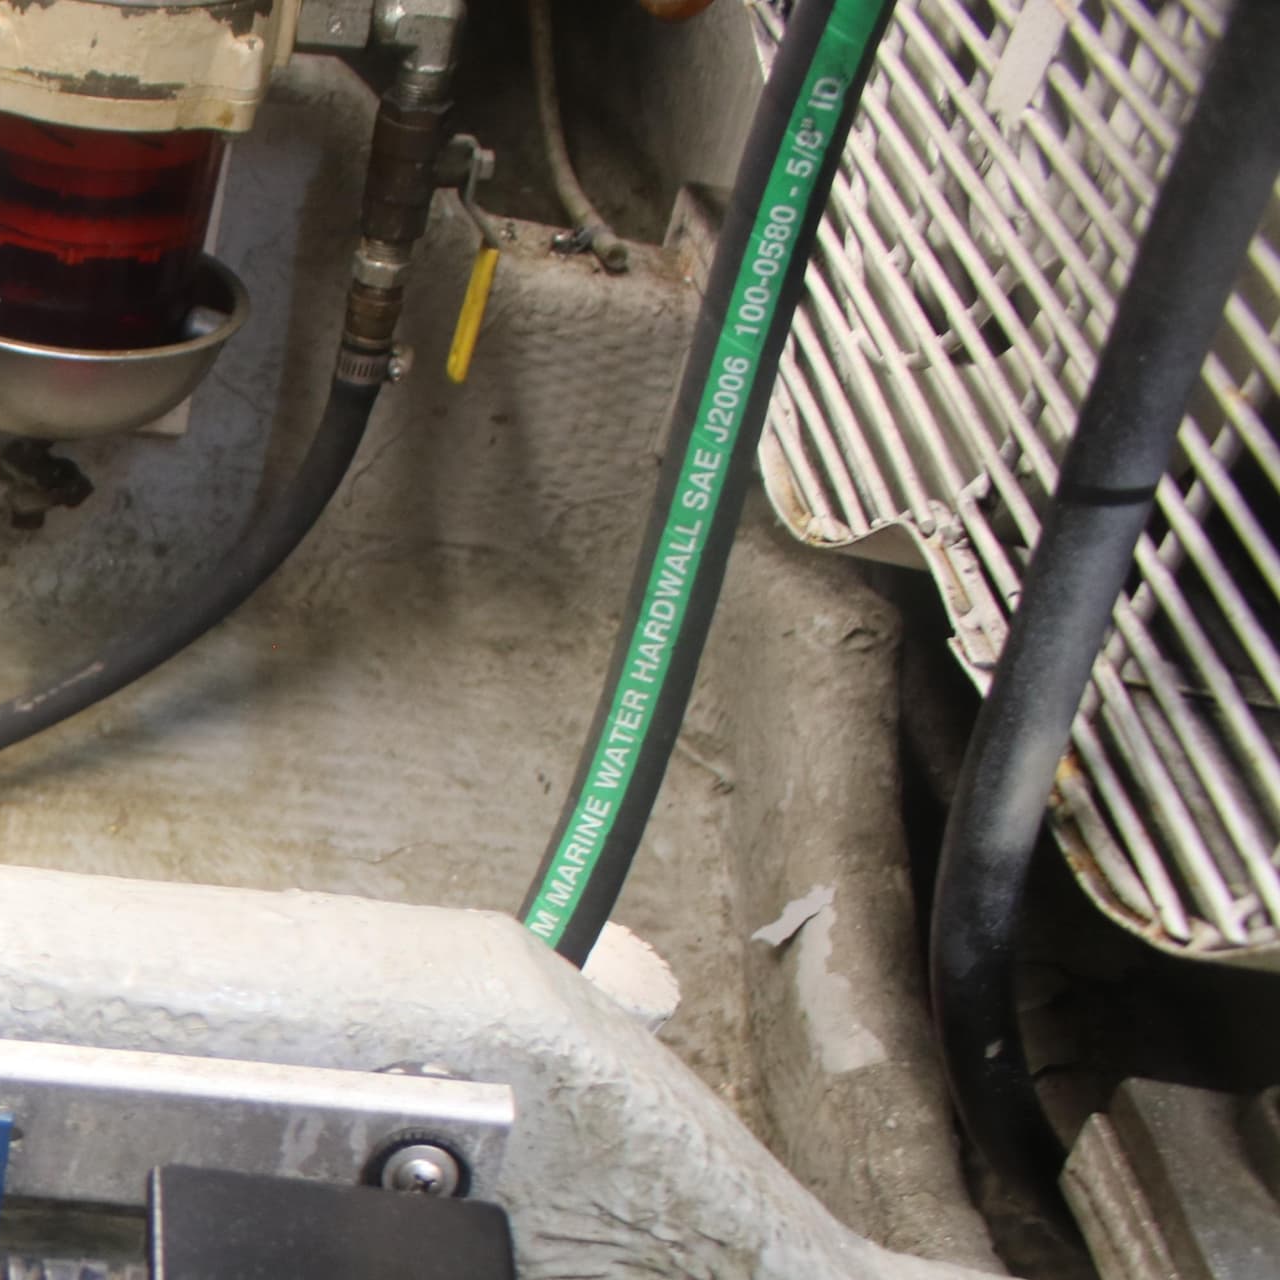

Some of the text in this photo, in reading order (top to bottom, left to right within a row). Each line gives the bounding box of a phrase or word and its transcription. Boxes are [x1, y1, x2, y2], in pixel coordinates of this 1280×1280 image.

[546, 795, 611, 907] MARINE
[593, 688, 649, 789] WATER
[630, 520, 703, 684] HARDWALL
[682, 448, 721, 511] SAE
[704, 355, 750, 444] J2006
[733, 204, 797, 337] 100-0580
[807, 76, 841, 111] ID
